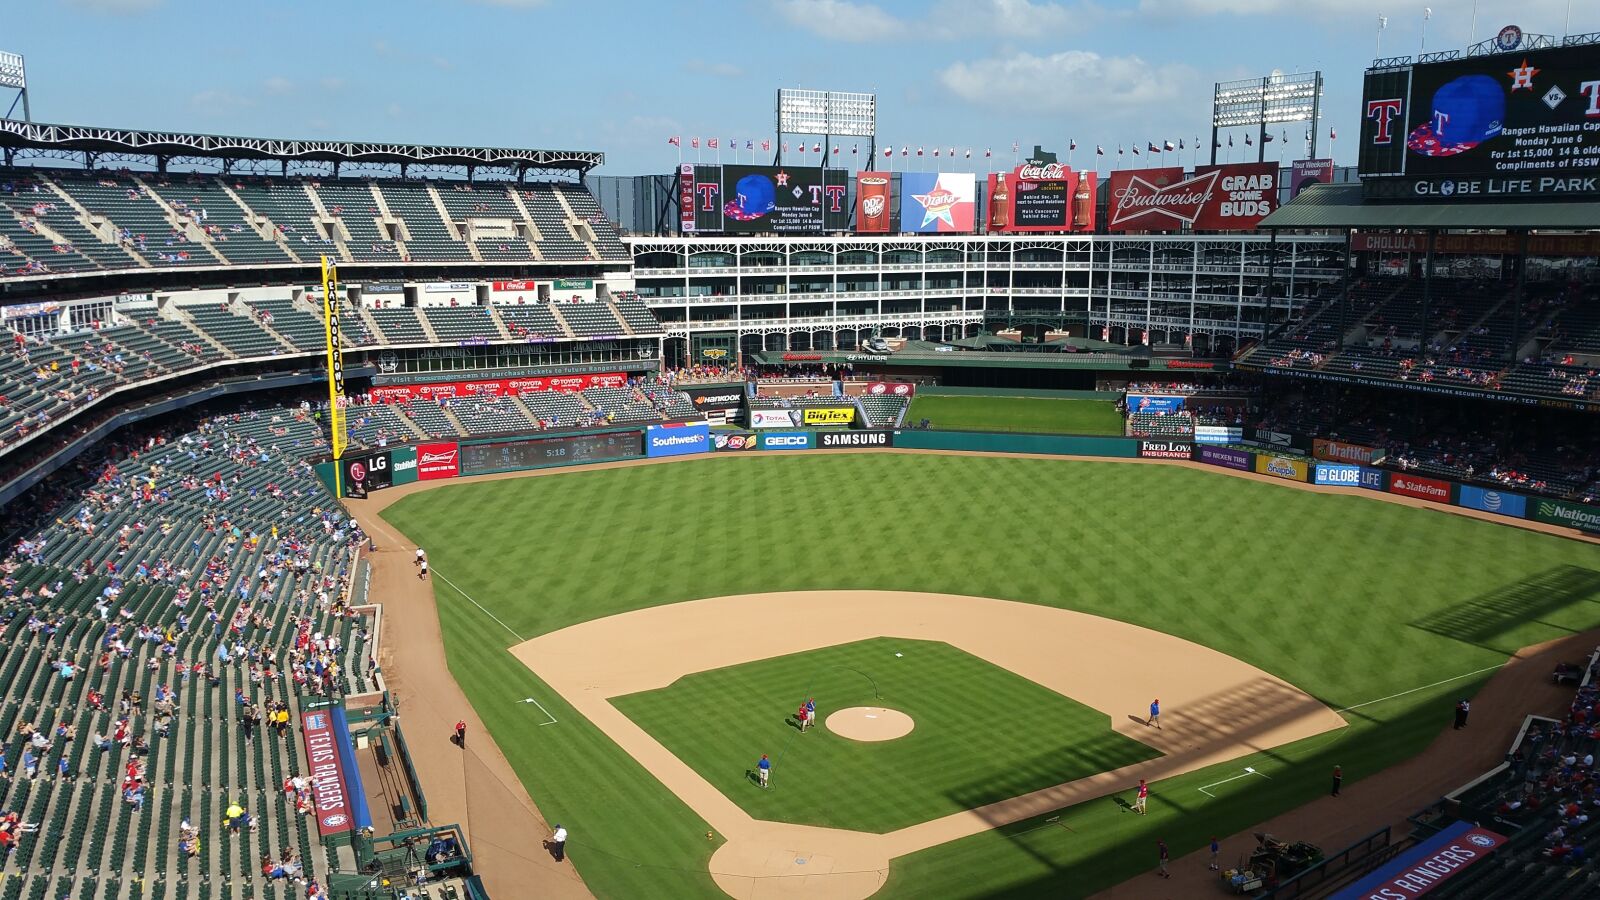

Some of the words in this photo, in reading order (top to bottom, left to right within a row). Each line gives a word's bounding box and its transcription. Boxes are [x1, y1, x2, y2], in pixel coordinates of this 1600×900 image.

[1512, 66, 1534, 88] H
[1367, 98, 1402, 144] T
[1502, 127, 1536, 136] Rangers
[1540, 123, 1580, 133] Hawaiian
[1516, 138, 1548, 146] Monday
[1552, 136, 1574, 144] June
[1507, 150, 1520, 158] 1st
[1524, 148, 1553, 158] 15,000
[1574, 147, 1579, 155] &
[1496, 160, 1555, 170] Compliments
[1572, 158, 1599, 166] FSSW
[1221, 174, 1272, 191] GRAB
[1488, 179, 1532, 193] LIFE
[1540, 178, 1597, 192] PARK
[697, 183, 718, 211] T
[826, 186, 845, 212] T
[1115, 187, 1213, 209] Budweiser
[1230, 190, 1262, 200] SOME
[1220, 201, 1270, 216] BUDS
[1367, 236, 1416, 249] CHOLULA
[328, 281, 336, 310] EAT
[330, 316, 338, 346] MOR
[421, 349, 440, 358] JACK
[334, 352, 343, 391] FOWL
[491, 370, 524, 378] purchase
[528, 368, 552, 376] tickets
[589, 365, 616, 373] Rangers
[704, 394, 740, 403] HANKOOK
[652, 436, 698, 446] Southwest
[765, 436, 807, 445] GEICO
[824, 434, 886, 445] SAMSUNG
[1142, 442, 1166, 451] FRED
[546, 448, 566, 456] 5:18
[1212, 452, 1232, 462] NEXEN
[1234, 456, 1247, 464] TIRE
[369, 456, 386, 471] LG
[1268, 464, 1296, 476] Snapple
[1329, 470, 1360, 481] GLOBE
[1362, 472, 1379, 485] LIFE
[309, 732, 334, 762] TEXAS
[315, 763, 344, 811] RANGERS
[1394, 846, 1475, 892] RANGERS
